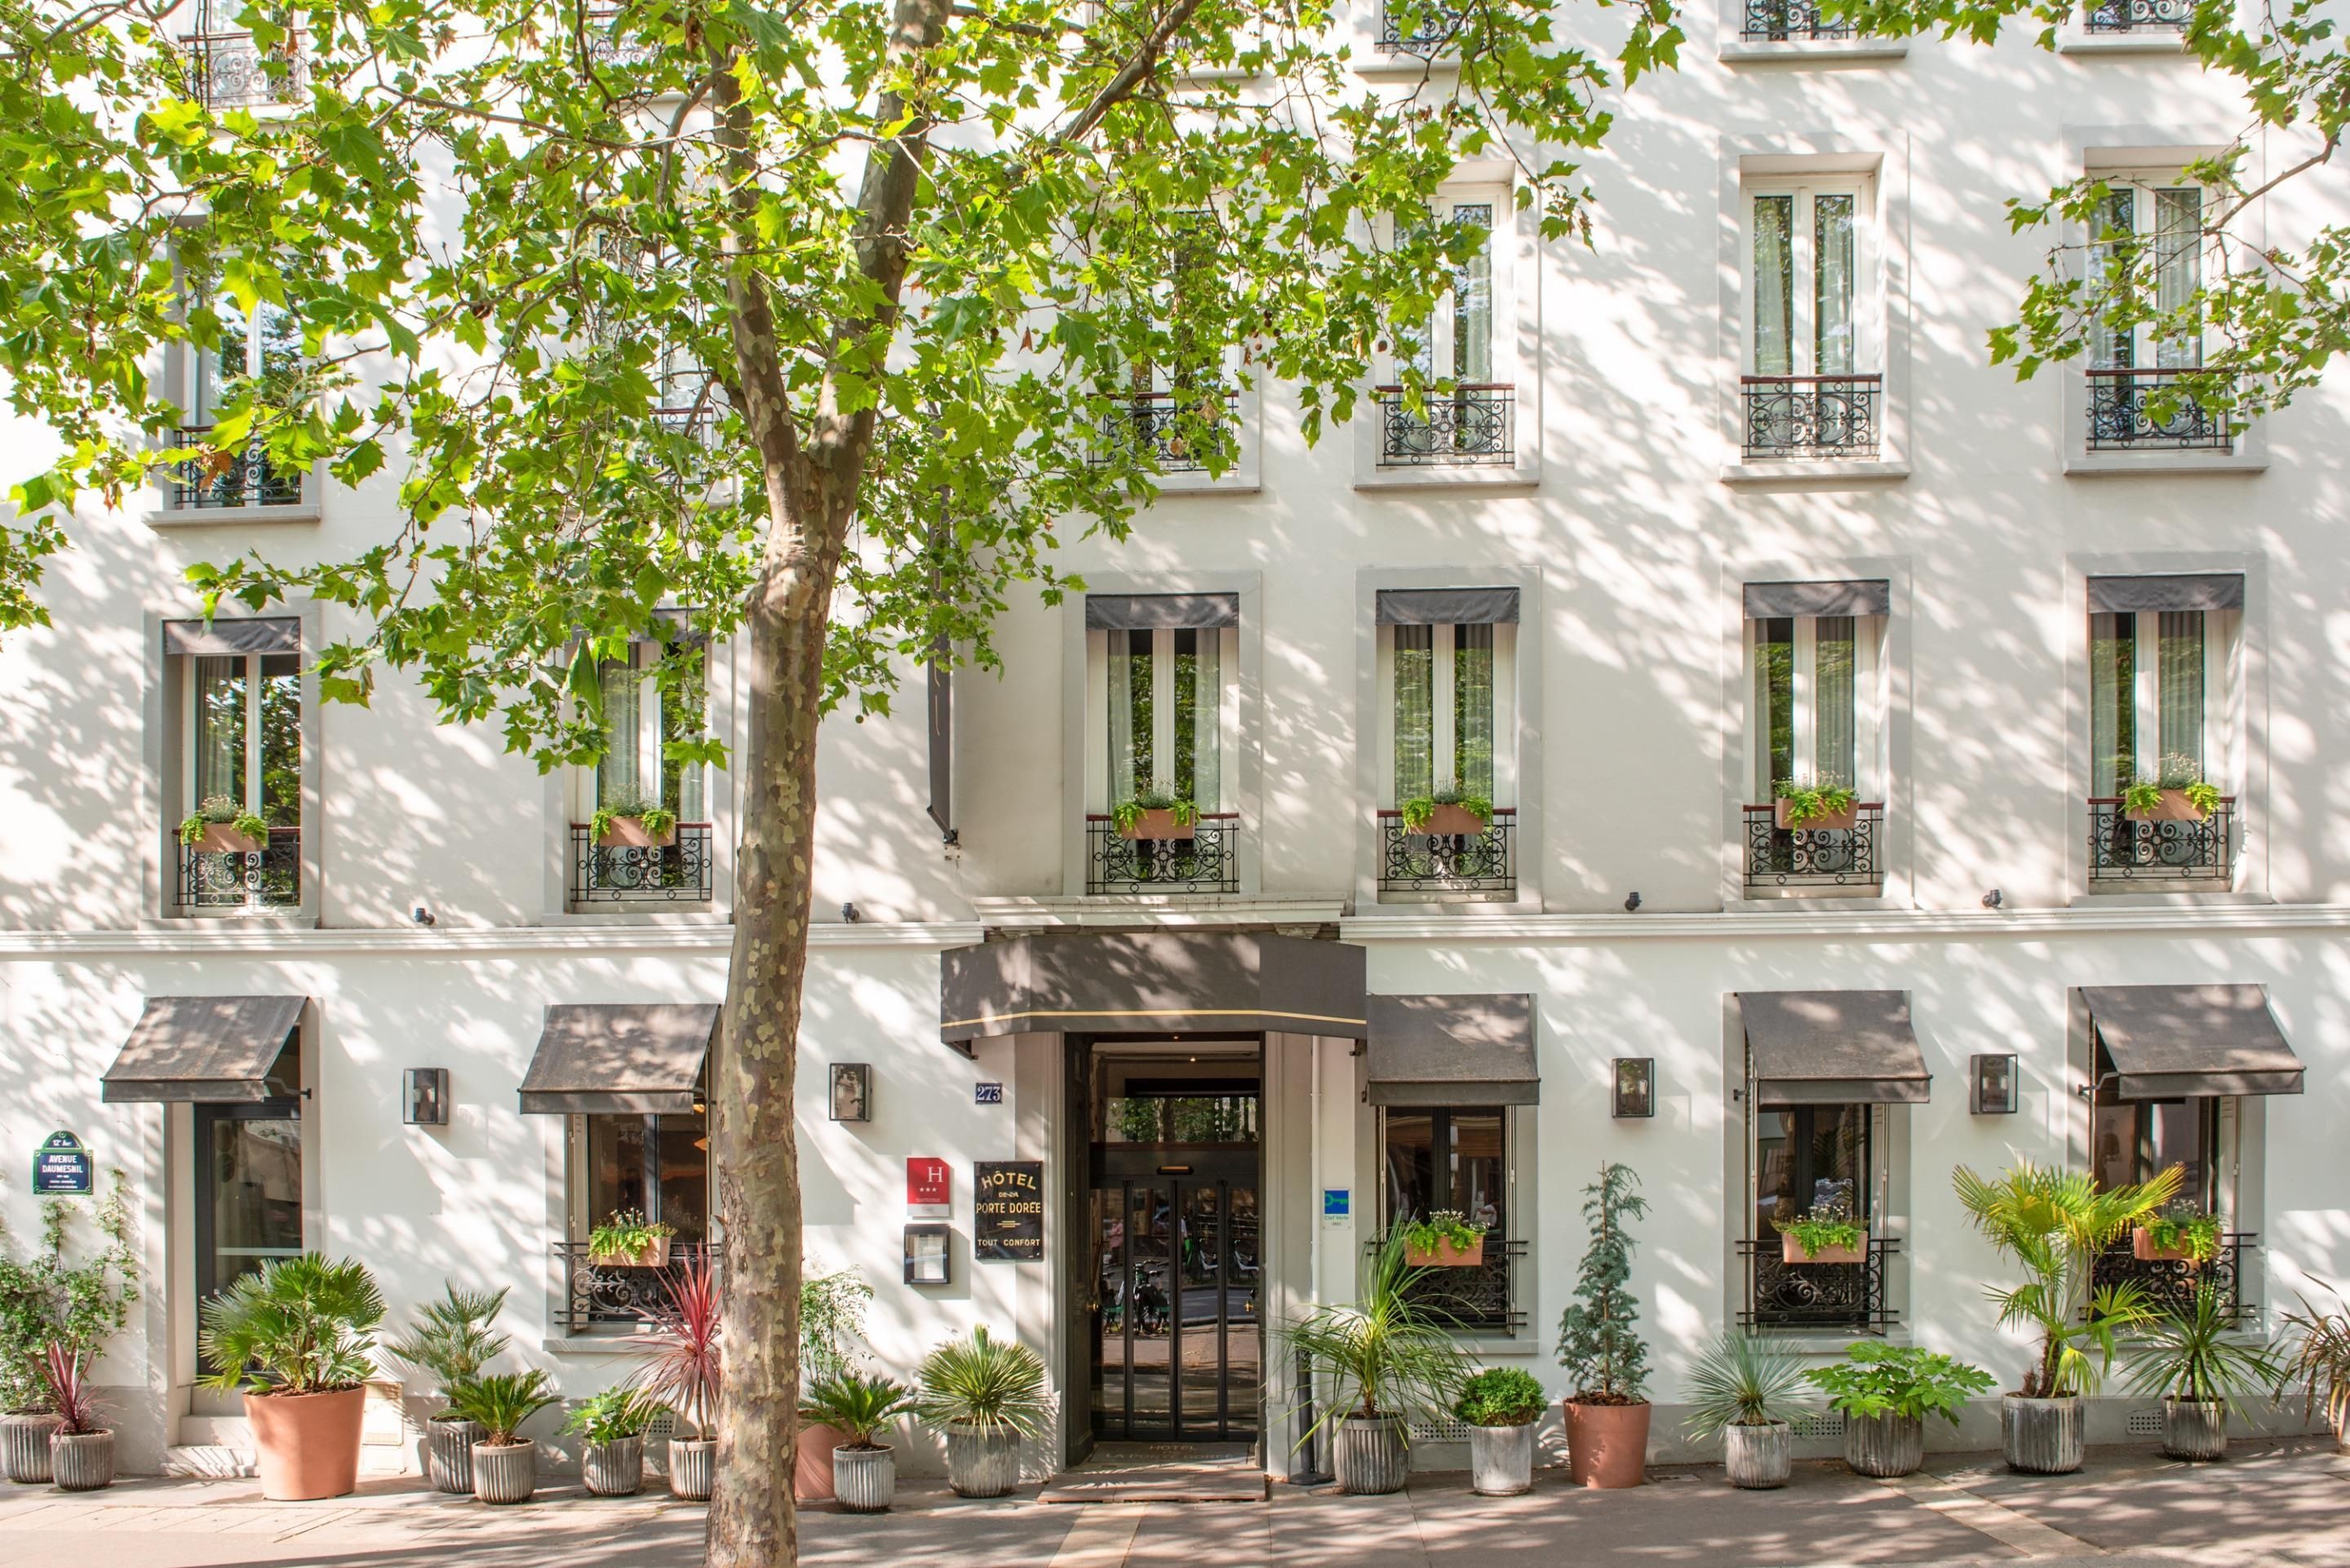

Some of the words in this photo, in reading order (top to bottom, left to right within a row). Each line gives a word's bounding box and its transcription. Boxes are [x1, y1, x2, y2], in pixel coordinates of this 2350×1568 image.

[977, 1086, 1001, 1101] 273
[49, 1155, 78, 1163] AVENUE
[42, 1165, 83, 1173] DAUMESNIL
[927, 1167, 944, 1183] H
[981, 1171, 1036, 1190] HÔTEL
[976, 1203, 1006, 1214] PORTE
[1009, 1201, 1041, 1214] DORÉE
